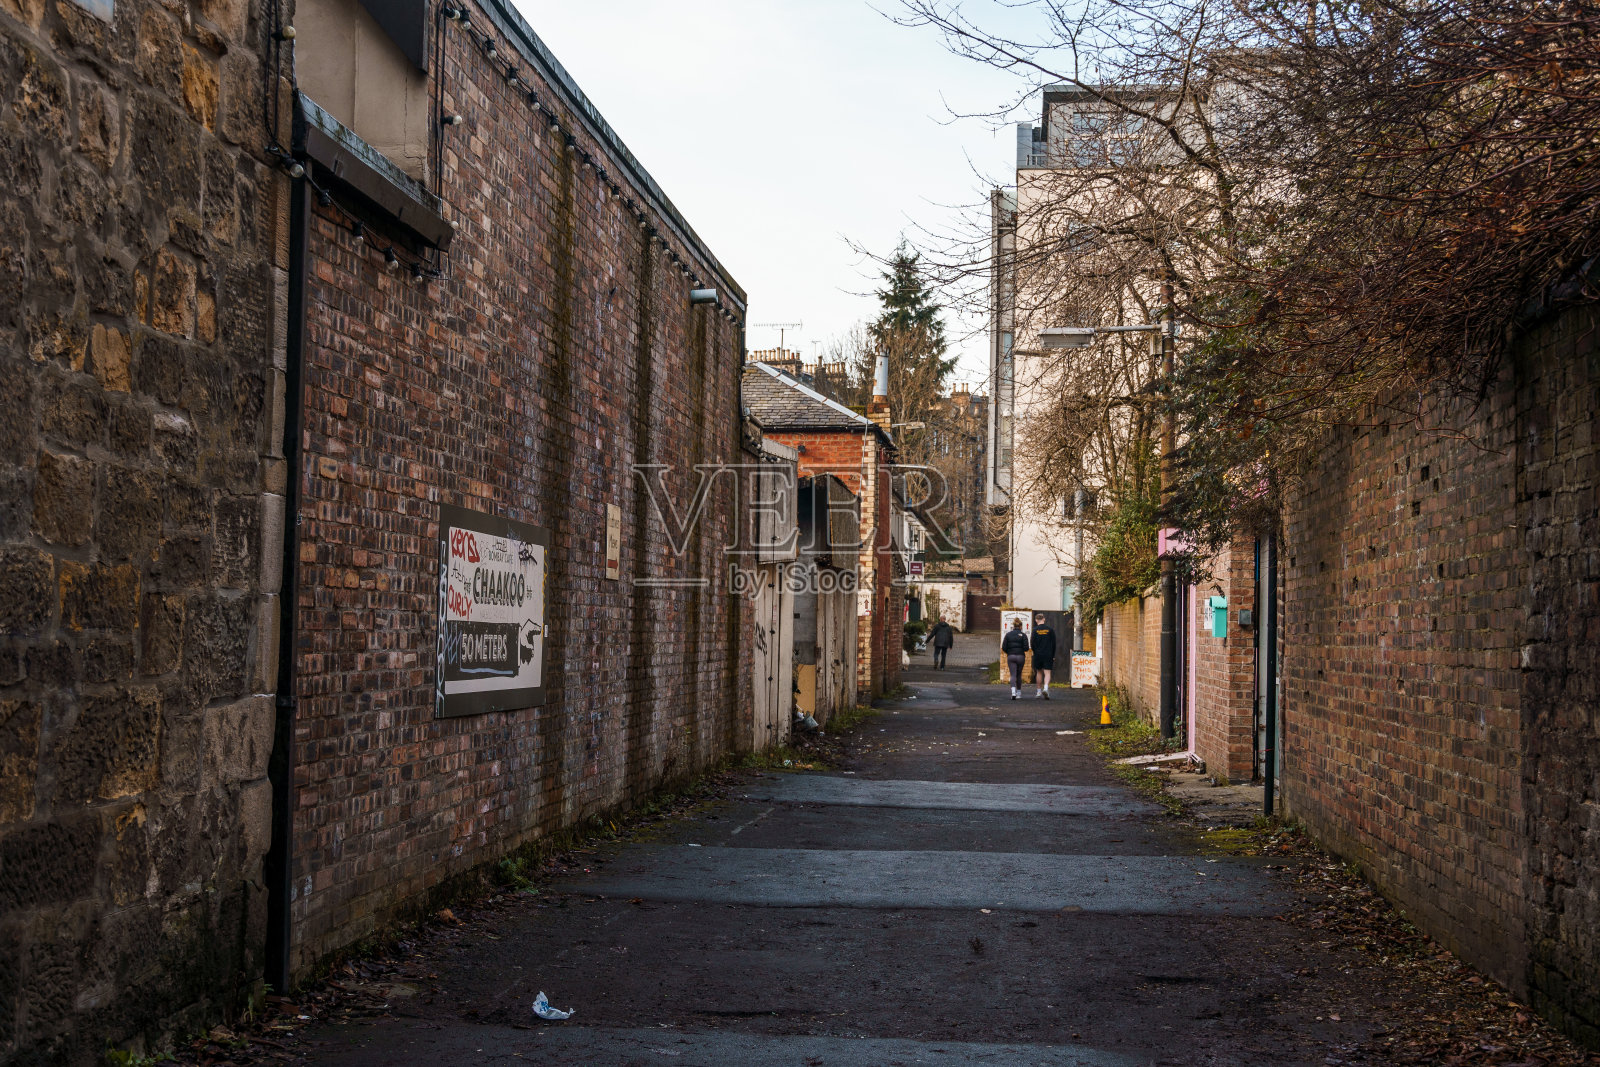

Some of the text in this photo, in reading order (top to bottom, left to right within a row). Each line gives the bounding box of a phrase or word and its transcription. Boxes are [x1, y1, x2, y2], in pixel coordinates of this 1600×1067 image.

[473, 567, 525, 607] CHAAKOO
[462, 634, 474, 663] 50
[1072, 657, 1097, 666] SHOPS
